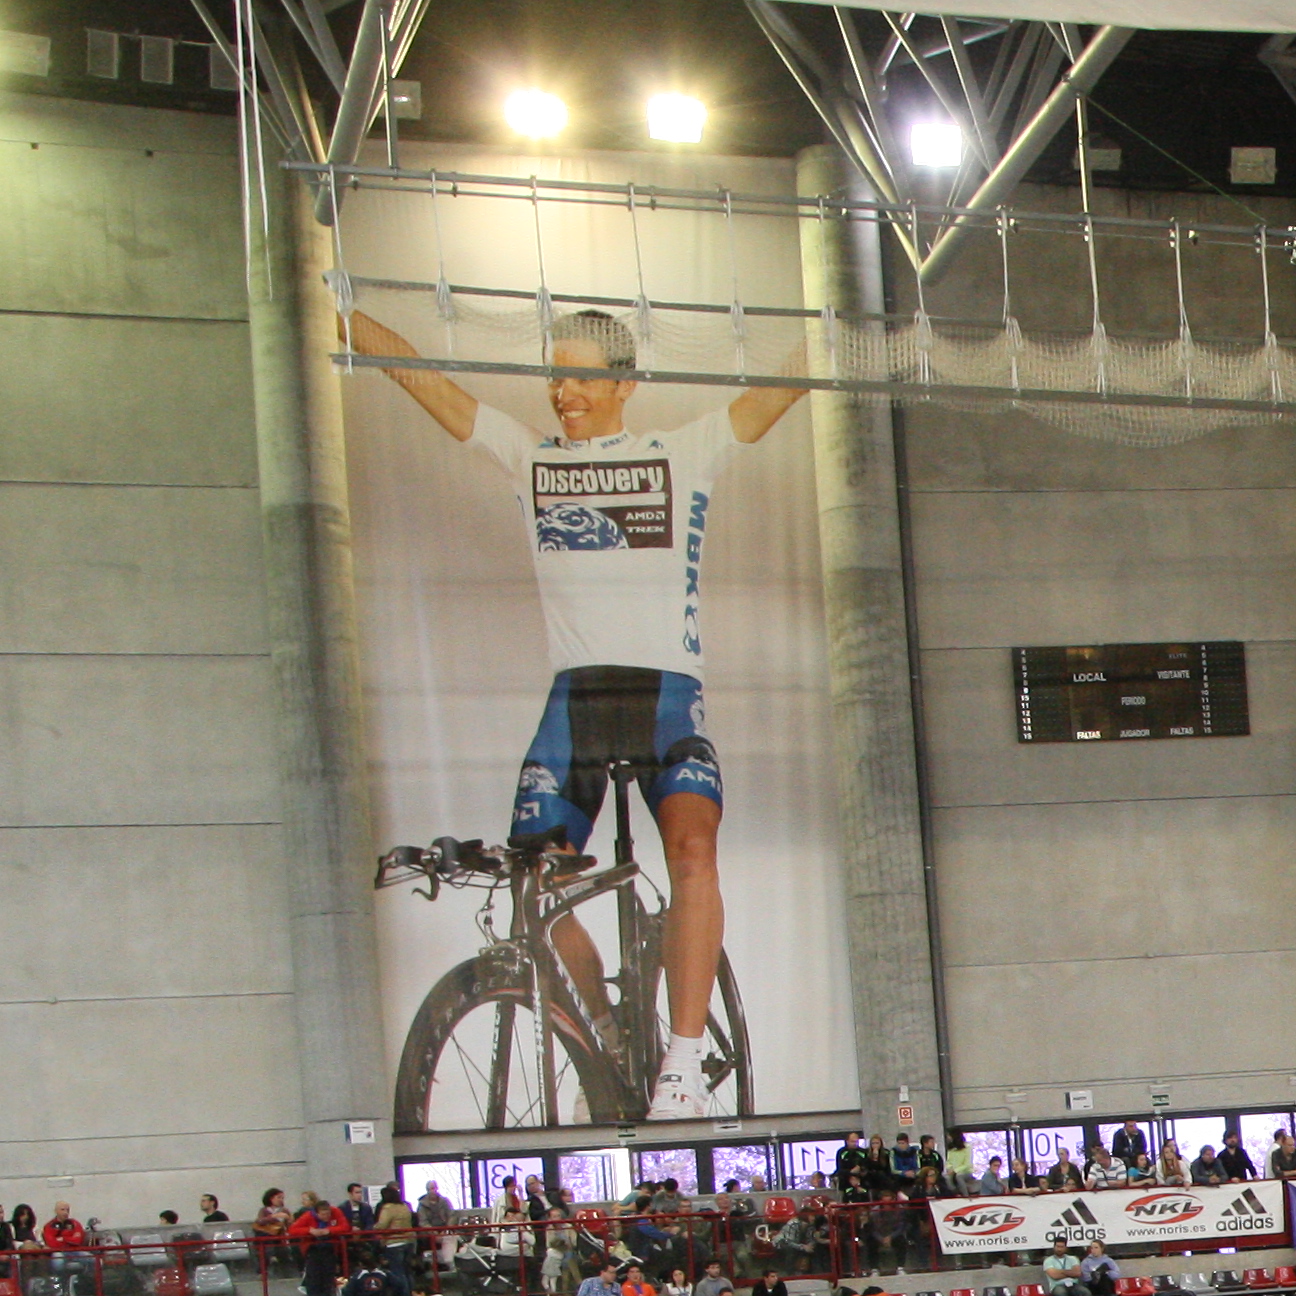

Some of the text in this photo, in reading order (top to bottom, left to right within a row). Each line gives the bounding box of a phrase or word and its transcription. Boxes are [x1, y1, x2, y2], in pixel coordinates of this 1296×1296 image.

[536, 465, 665, 493] Discovery
[625, 511, 656, 521] AMD
[626, 526, 665, 534] TREK
[1073, 672, 1107, 683] LOCAL
[1157, 669, 1190, 680] VISITANTE
[1076, 730, 1101, 740] FALTAS
[1170, 727, 1194, 736] FALTAS
[1134, 1201, 1203, 1217] NKL
[952, 1212, 1021, 1228] NKL
[1216, 1213, 1275, 1232] adidas
[1045, 1225, 1107, 1243] adidas
[1126, 1223, 1206, 1238] www.noris.es
[944, 1234, 1028, 1249] www.noris.es
